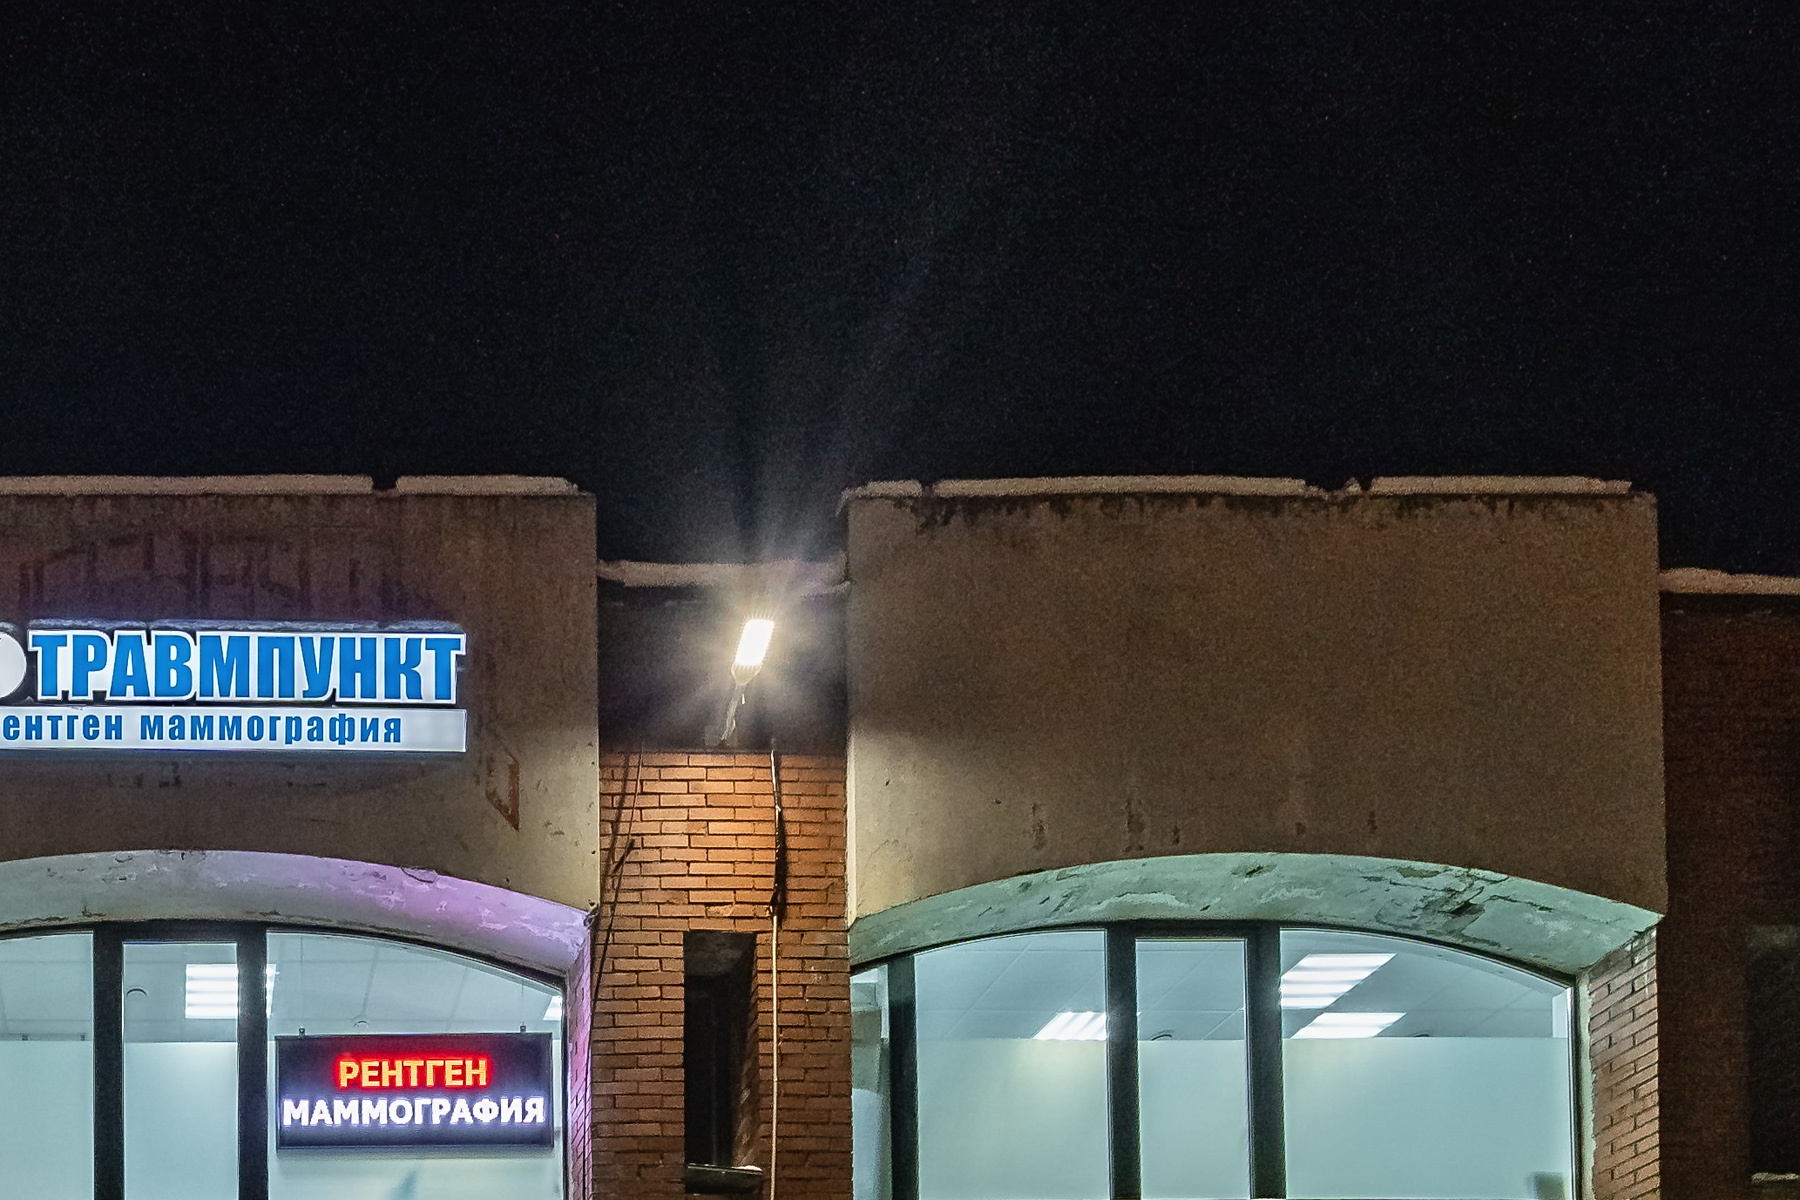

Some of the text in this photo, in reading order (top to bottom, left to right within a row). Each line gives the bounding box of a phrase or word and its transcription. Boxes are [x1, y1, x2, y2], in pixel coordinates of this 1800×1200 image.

[30, 630, 462, 702] ТРАВМПУНКТ
[140, 710, 402, 745] маммография
[338, 1059, 488, 1088] РЕНТГЕН
[282, 1097, 546, 1126] МАММОГРАФИЯ
